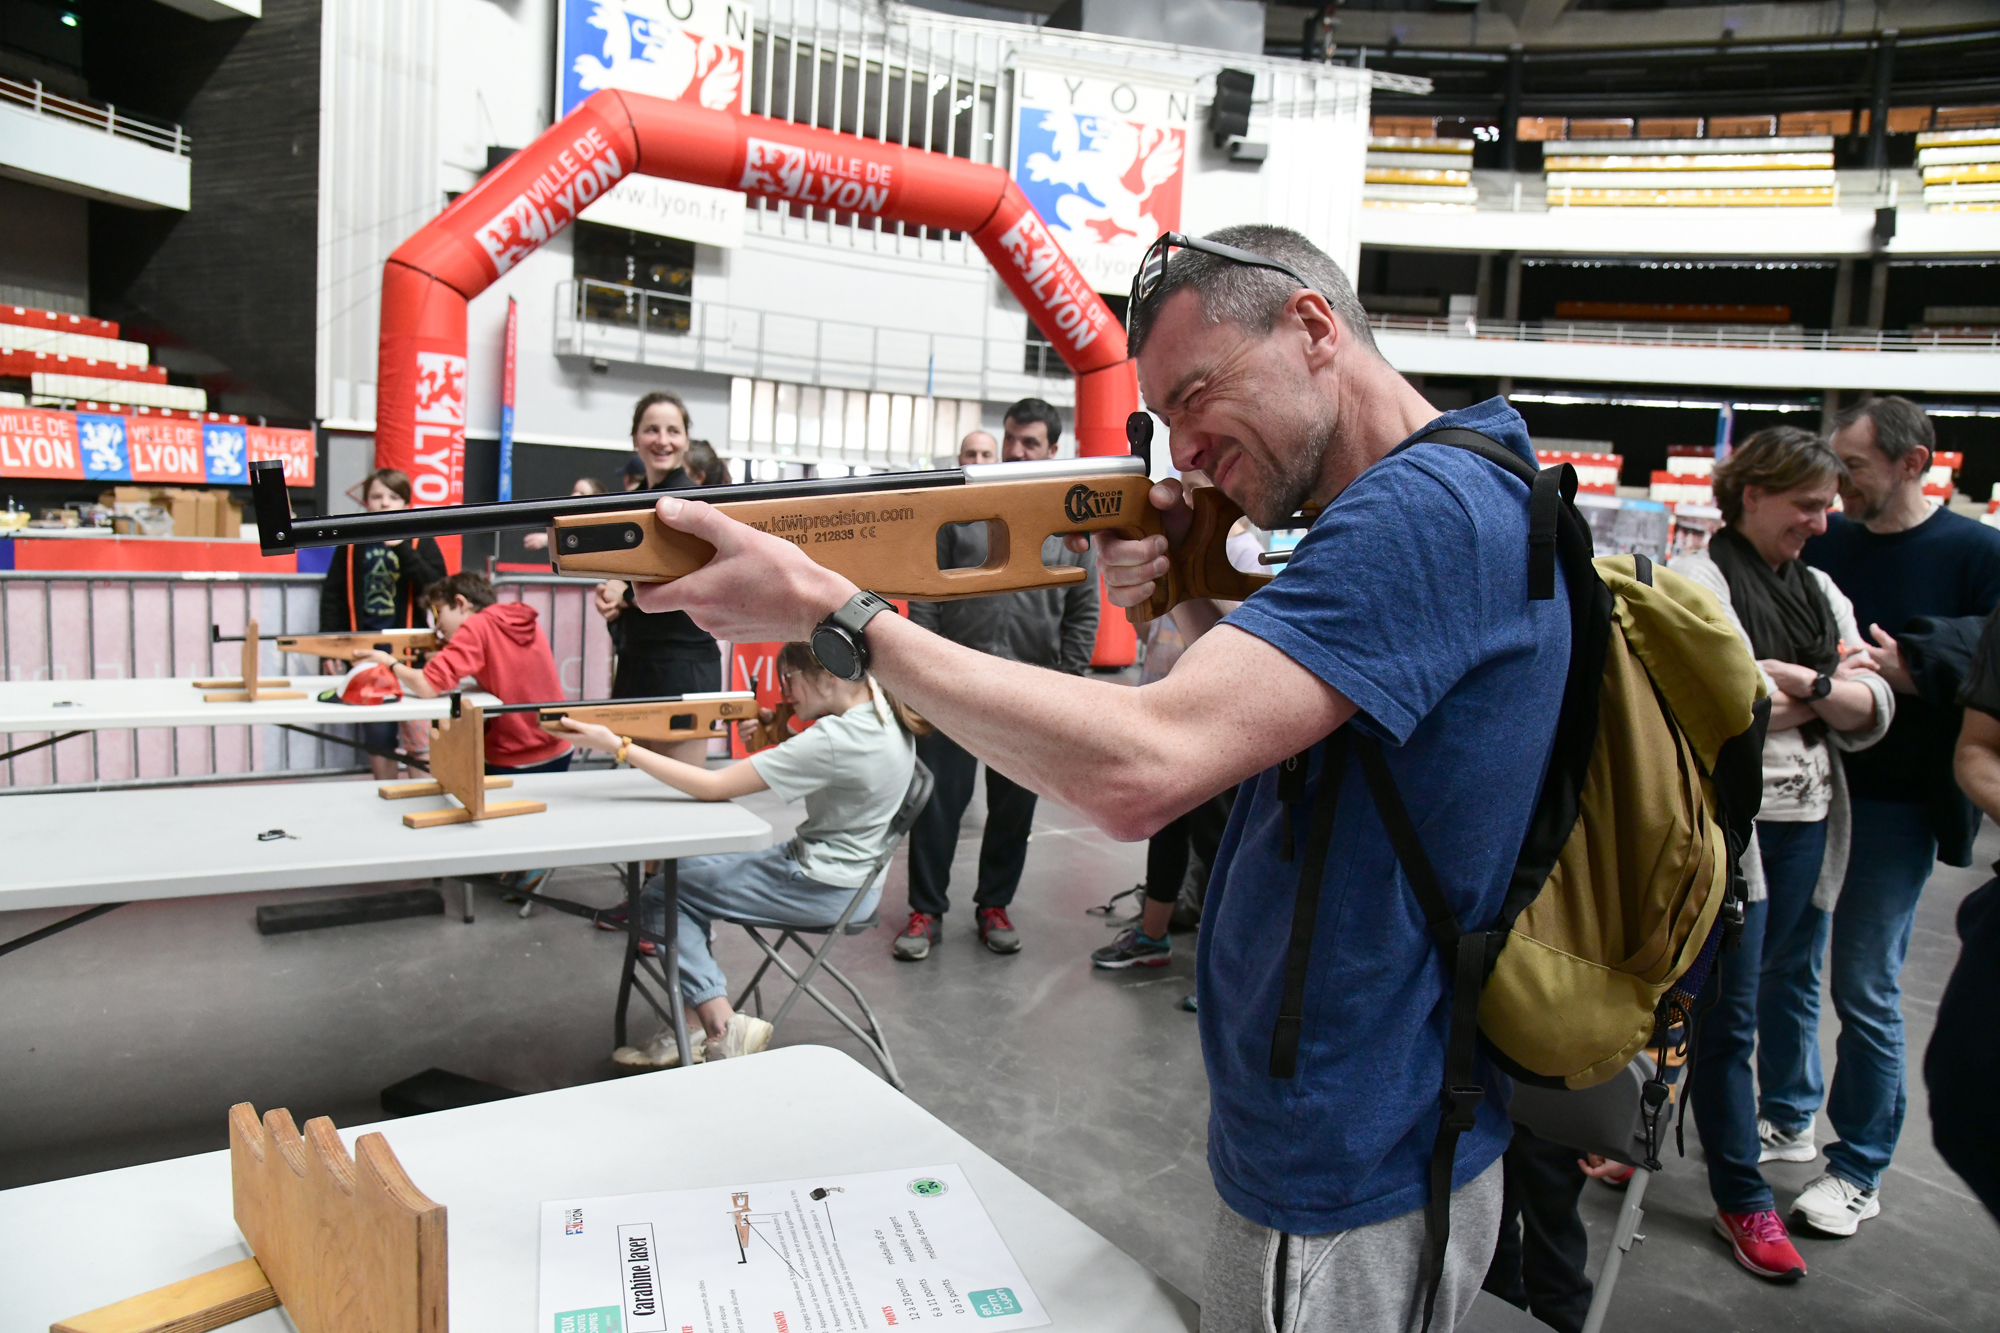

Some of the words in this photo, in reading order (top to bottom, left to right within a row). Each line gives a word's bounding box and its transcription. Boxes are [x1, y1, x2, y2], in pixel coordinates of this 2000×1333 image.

[1021, 70, 1189, 121] LYON
[526, 149, 580, 206] VILLE
[573, 126, 608, 161] DE
[804, 150, 862, 180] VILLE
[866, 162, 892, 186] DE
[542, 149, 624, 232] LYON
[800, 173, 890, 213] LYON
[1055, 256, 1092, 308] VILLE
[1086, 302, 1109, 332] DE
[1031, 270, 1098, 350] LYON
[0, 414, 44, 436] VILLE
[46, 416, 70, 438] DE
[131, 424, 172, 444] VILLE
[176, 427, 197, 446] DE
[0, 435, 75, 470] LYON
[250, 433, 288, 451] VILLE
[290, 436, 310, 454] DE
[134, 446, 198, 474] LYON
[413, 425, 450, 509] LYO
[450, 429, 465, 494] VILLE
[572, 1208, 583, 1224] LYON
[908, 1210, 922, 1228] bronze
[916, 1228, 926, 1236] de
[628, 1237, 649, 1262] laser
[878, 1240, 895, 1264] médaille
[899, 1238, 916, 1262] médaille
[920, 1236, 938, 1260] médaille
[630, 1264, 656, 1316] Carabine
[896, 1278, 912, 1298] points
[919, 1278, 935, 1298] points
[942, 1279, 959, 1298] points
[996, 1289, 1014, 1310] Lyon
[902, 1298, 914, 1306] 20
[980, 1304, 992, 1316] en
[986, 1294, 1004, 1314] form
[561, 1316, 574, 1333] EUX
[577, 1314, 586, 1333] OUTES
[774, 1311, 790, 1333] NSIGNES
[882, 1306, 898, 1326] POINTS
[909, 1312, 920, 1320] 12
